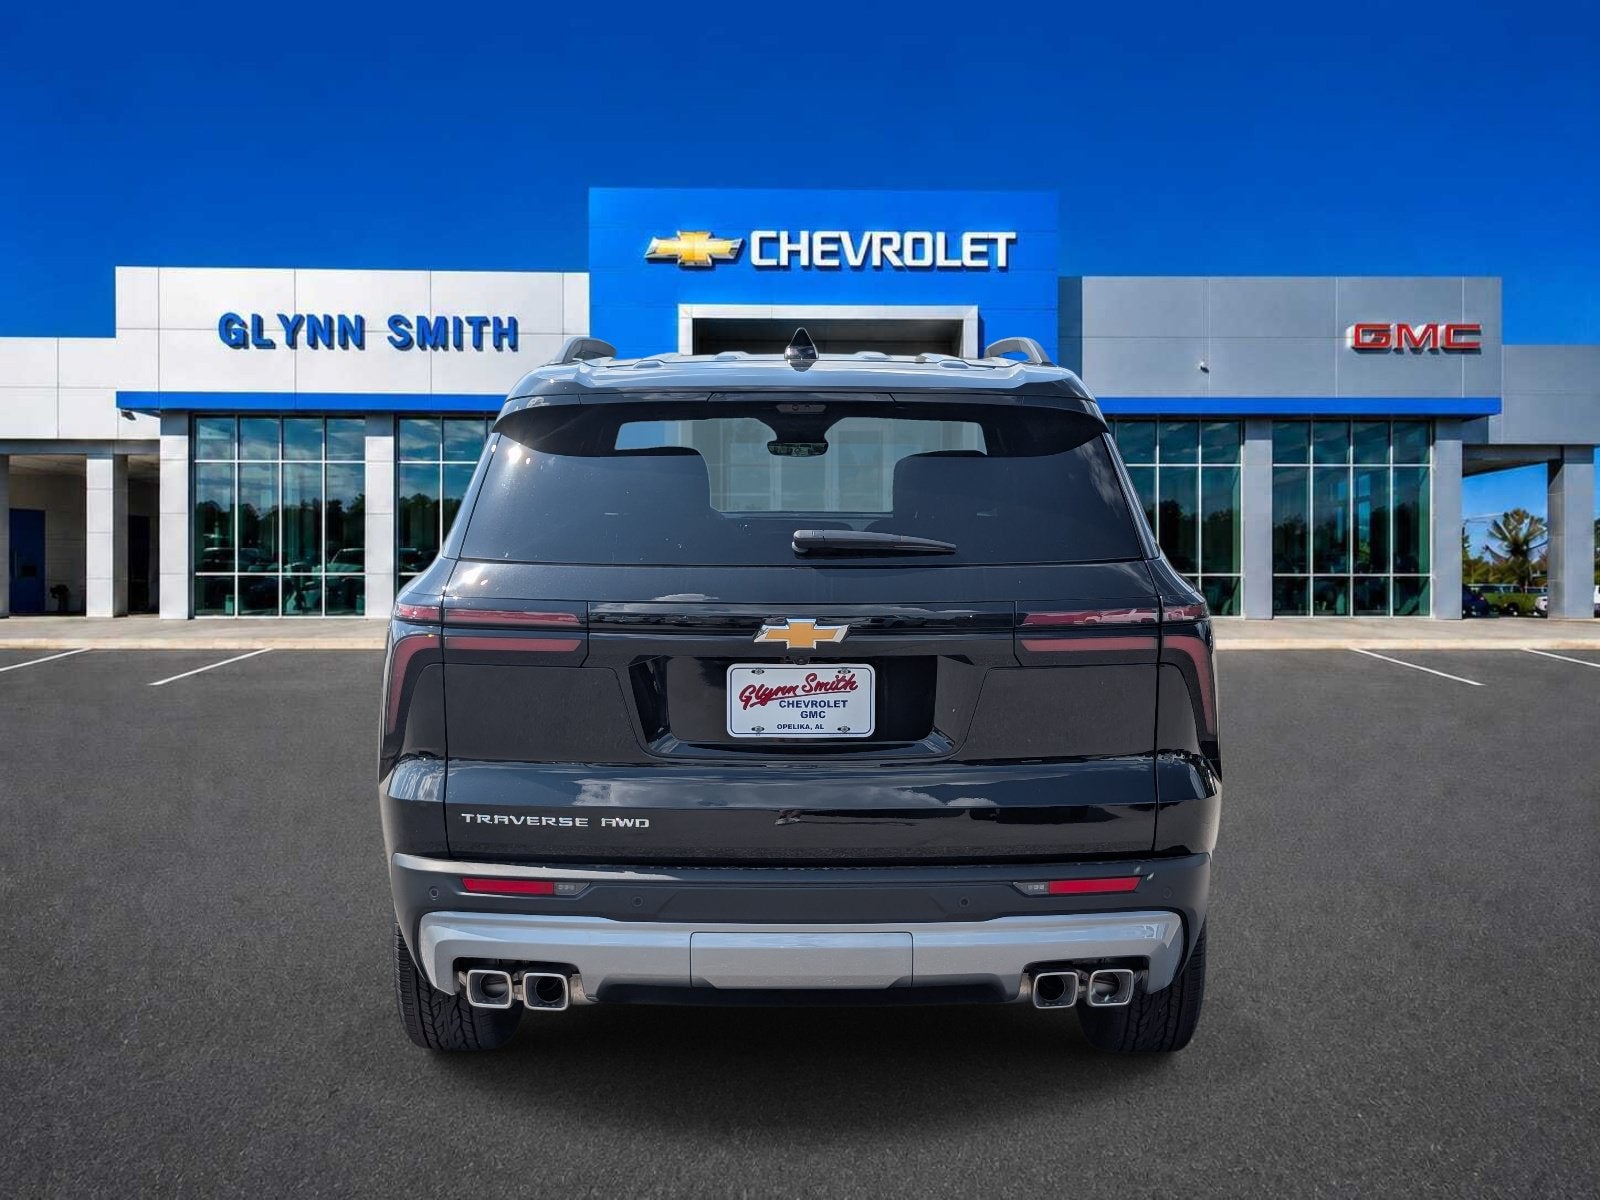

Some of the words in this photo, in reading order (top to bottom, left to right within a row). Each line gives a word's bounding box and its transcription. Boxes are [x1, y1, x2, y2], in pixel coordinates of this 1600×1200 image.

[750, 230, 1017, 268] CHEVROLET
[218, 312, 365, 351] GLYNN
[387, 314, 519, 352] SMITH
[1350, 322, 1482, 352] GMC
[738, 683, 799, 711] Glynn
[801, 672, 859, 693] Smith
[778, 700, 848, 709] CHEVROLET
[800, 710, 826, 719] GMC
[776, 723, 813, 731] OPELIKA,
[461, 813, 589, 827] TRAVERSE
[600, 817, 650, 828] AWD
